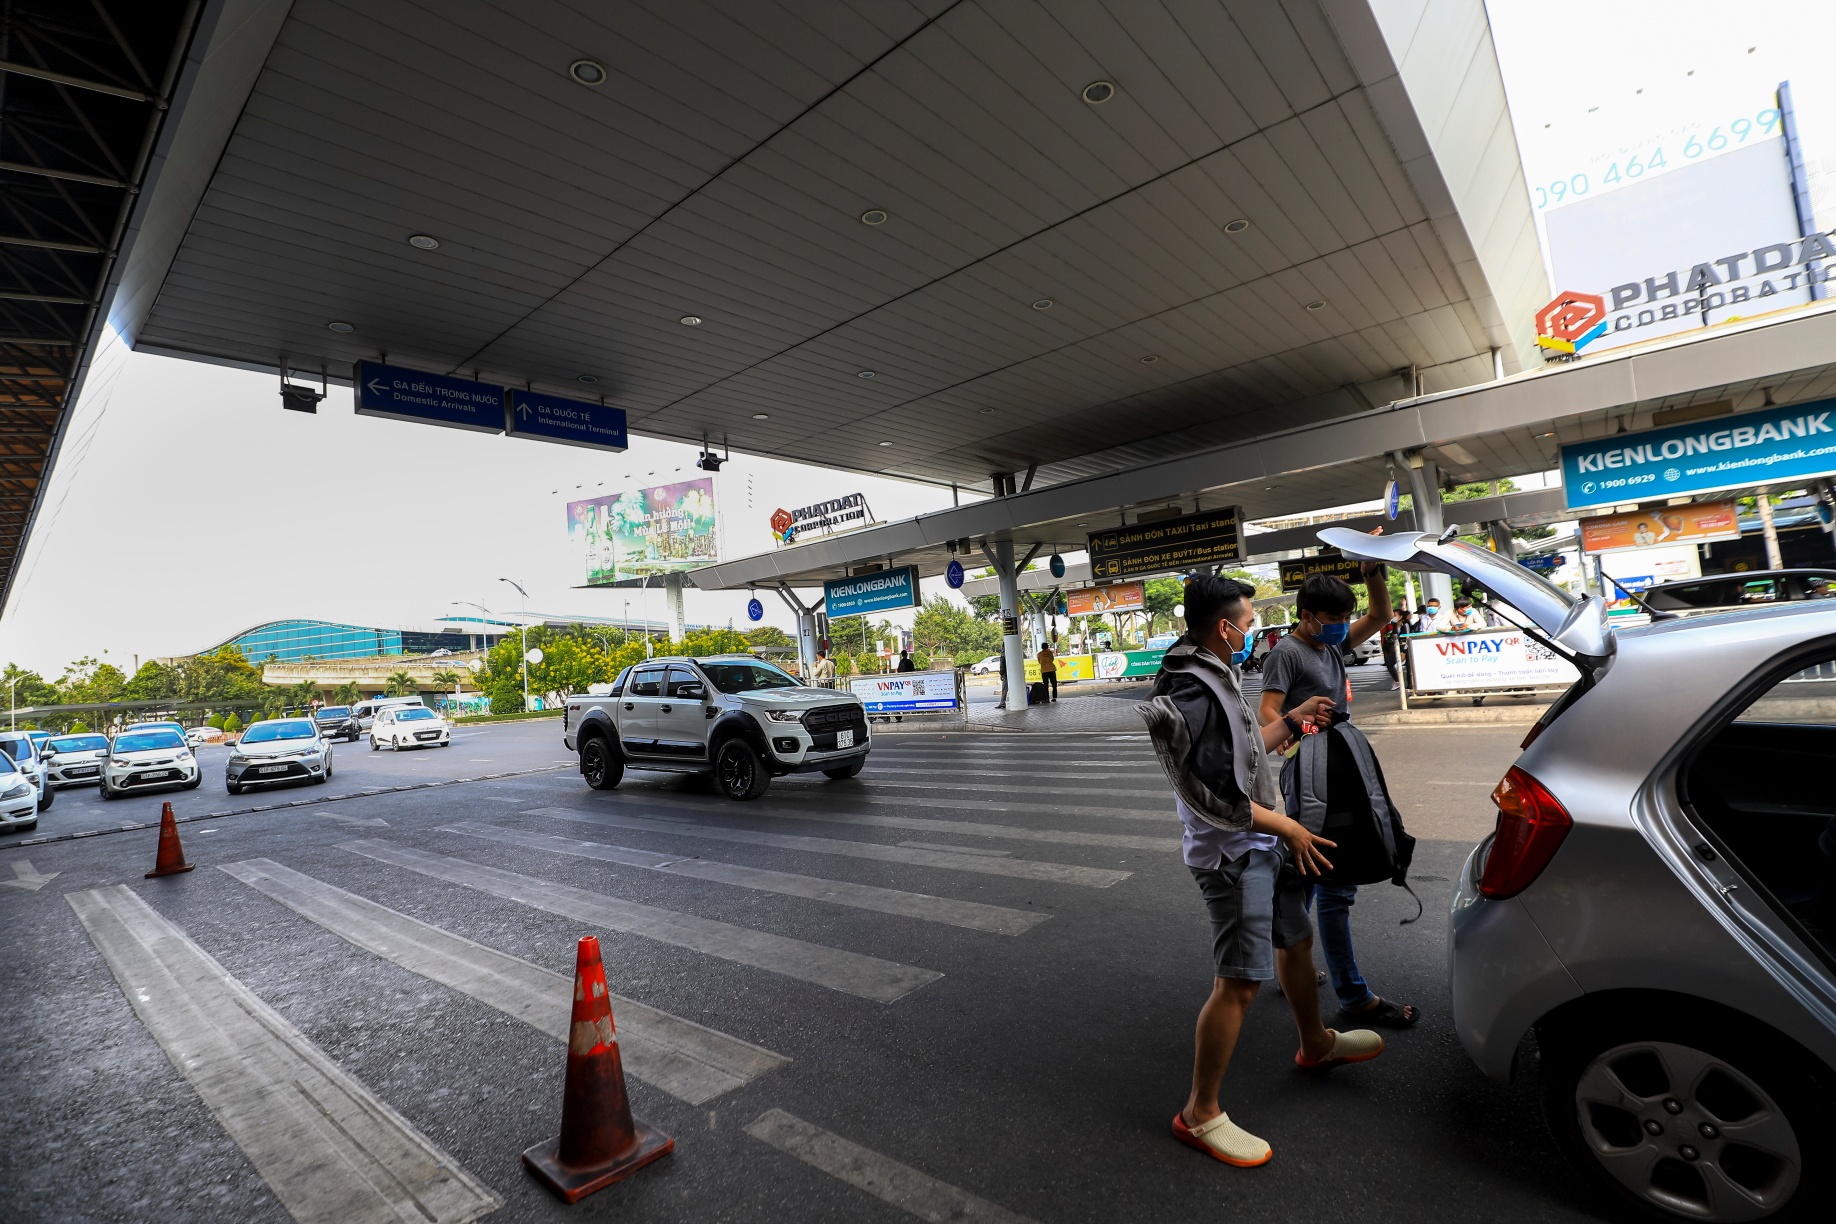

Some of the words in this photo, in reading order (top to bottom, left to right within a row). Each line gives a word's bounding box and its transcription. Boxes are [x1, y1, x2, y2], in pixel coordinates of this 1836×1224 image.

[1603, 147, 1668, 184] 464
[1683, 108, 1781, 159] 6699
[393, 380, 409, 390] GA
[411, 381, 432, 395] ĐẾN
[435, 387, 470, 401] TRONG
[472, 392, 499, 405] NƯỚC
[393, 392, 439, 407] Domestic
[441, 400, 476, 413] Arrivals
[538, 405, 551, 415] GA
[553, 406, 578, 419] QUỐC
[580, 411, 591, 422] TẾ
[538, 416, 586, 431] International
[588, 424, 619, 437] Terminal
[1578, 412, 1834, 474] KIENLONGBANK
[1600, 477, 1626, 489] 1900
[1628, 473, 1656, 486] 6929
[1686, 445, 1836, 477] www.kienlongbank.com
[792, 492, 862, 522] PHATDAT
[794, 510, 865, 534] CORPORATION
[1211, 517, 1236, 528] stand
[1161, 552, 1172, 561] XE
[1213, 542, 1238, 553] station
[830, 574, 907, 599] KIENLONGBANK
[1446, 656, 1467, 665] Scan
[1469, 655, 1479, 664] to
[1482, 654, 1499, 664] Pay
